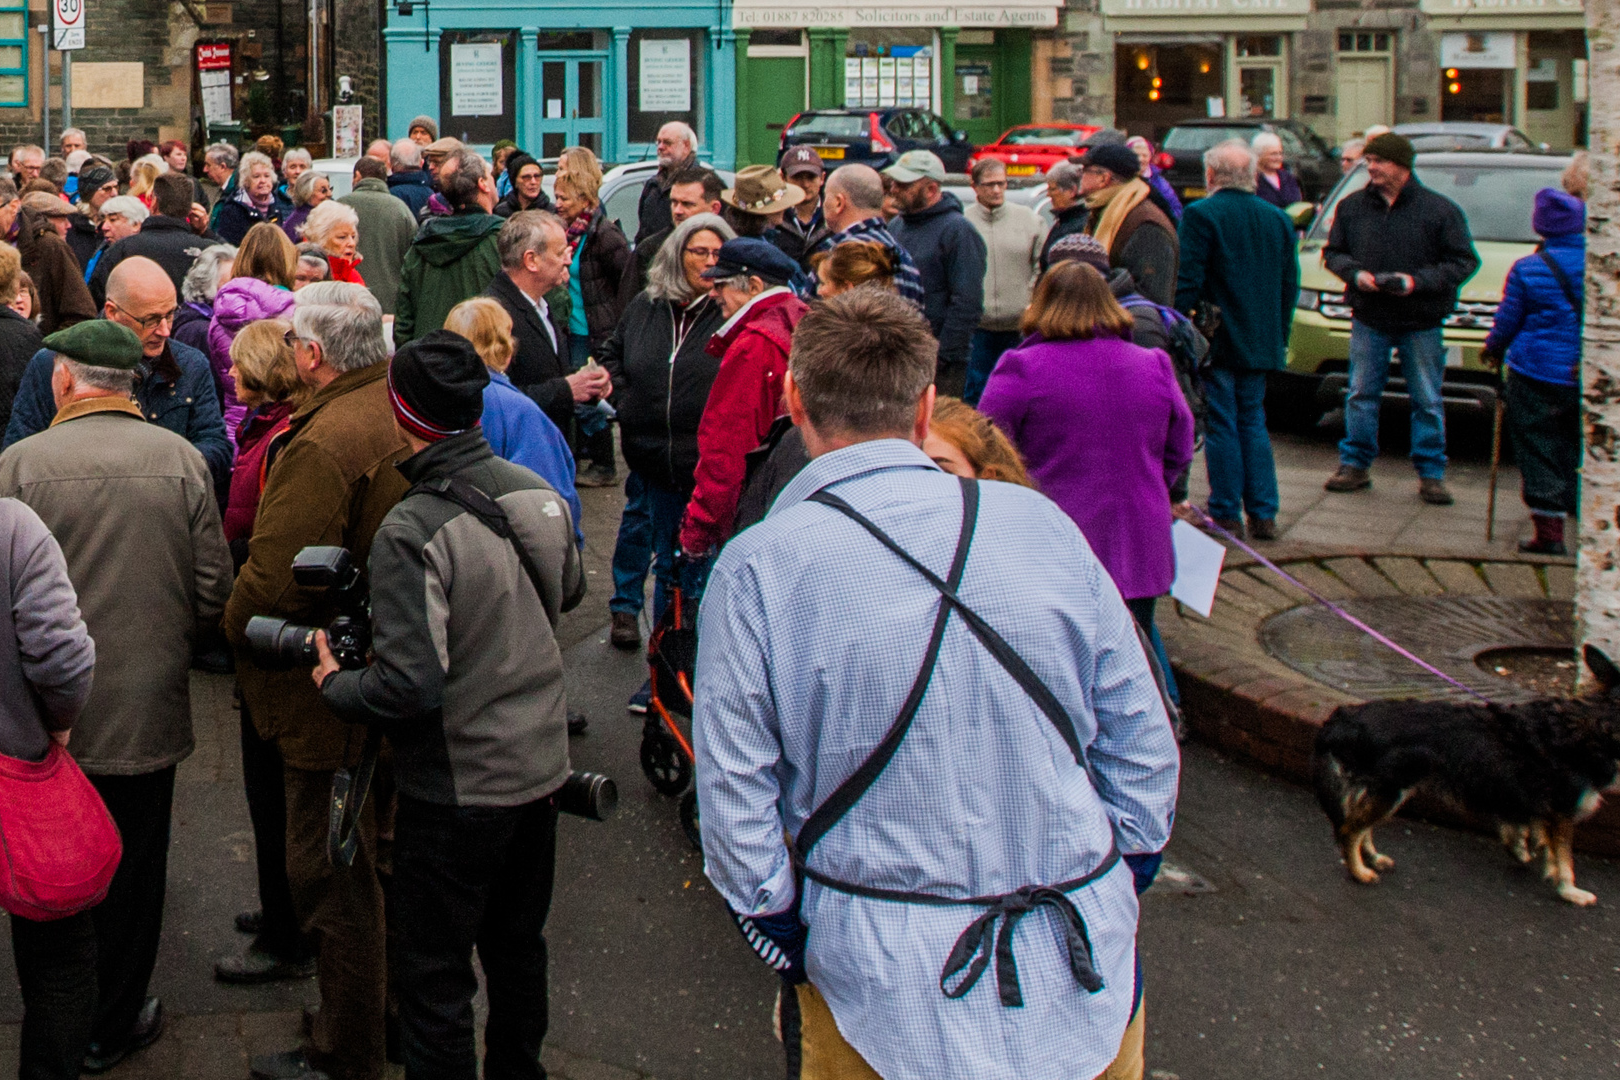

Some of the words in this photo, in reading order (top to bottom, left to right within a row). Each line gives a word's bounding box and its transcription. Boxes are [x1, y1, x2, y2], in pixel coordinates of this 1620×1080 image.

[739, 11, 759, 22] Tel:
[763, 10, 799, 22] 01887
[802, 9, 844, 22] 820285
[855, 8, 921, 22] Solicitors
[924, 7, 949, 22] and
[955, 8, 995, 22] Estate
[1000, 8, 1047, 25] Agents
